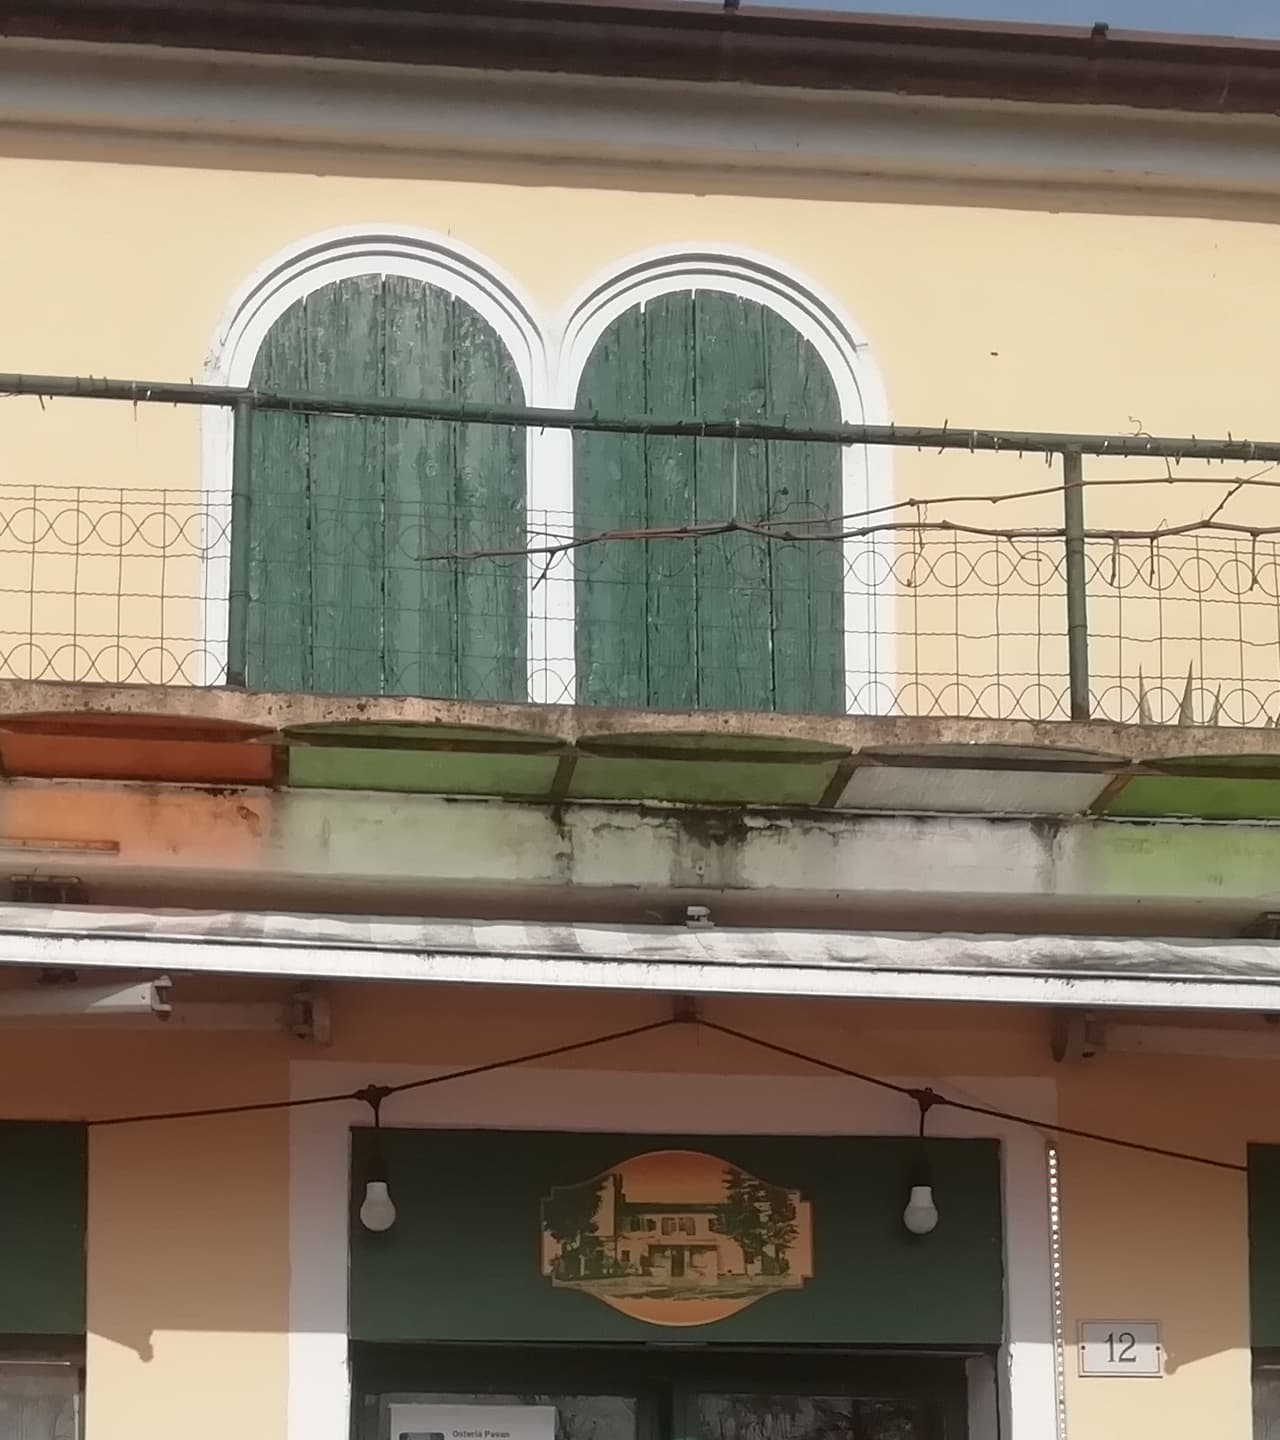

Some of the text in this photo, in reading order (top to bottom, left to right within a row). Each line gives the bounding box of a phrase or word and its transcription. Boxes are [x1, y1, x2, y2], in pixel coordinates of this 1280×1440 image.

[1104, 1332, 1137, 1362] 12
[452, 1430, 510, 1438] Osteria Pavan
